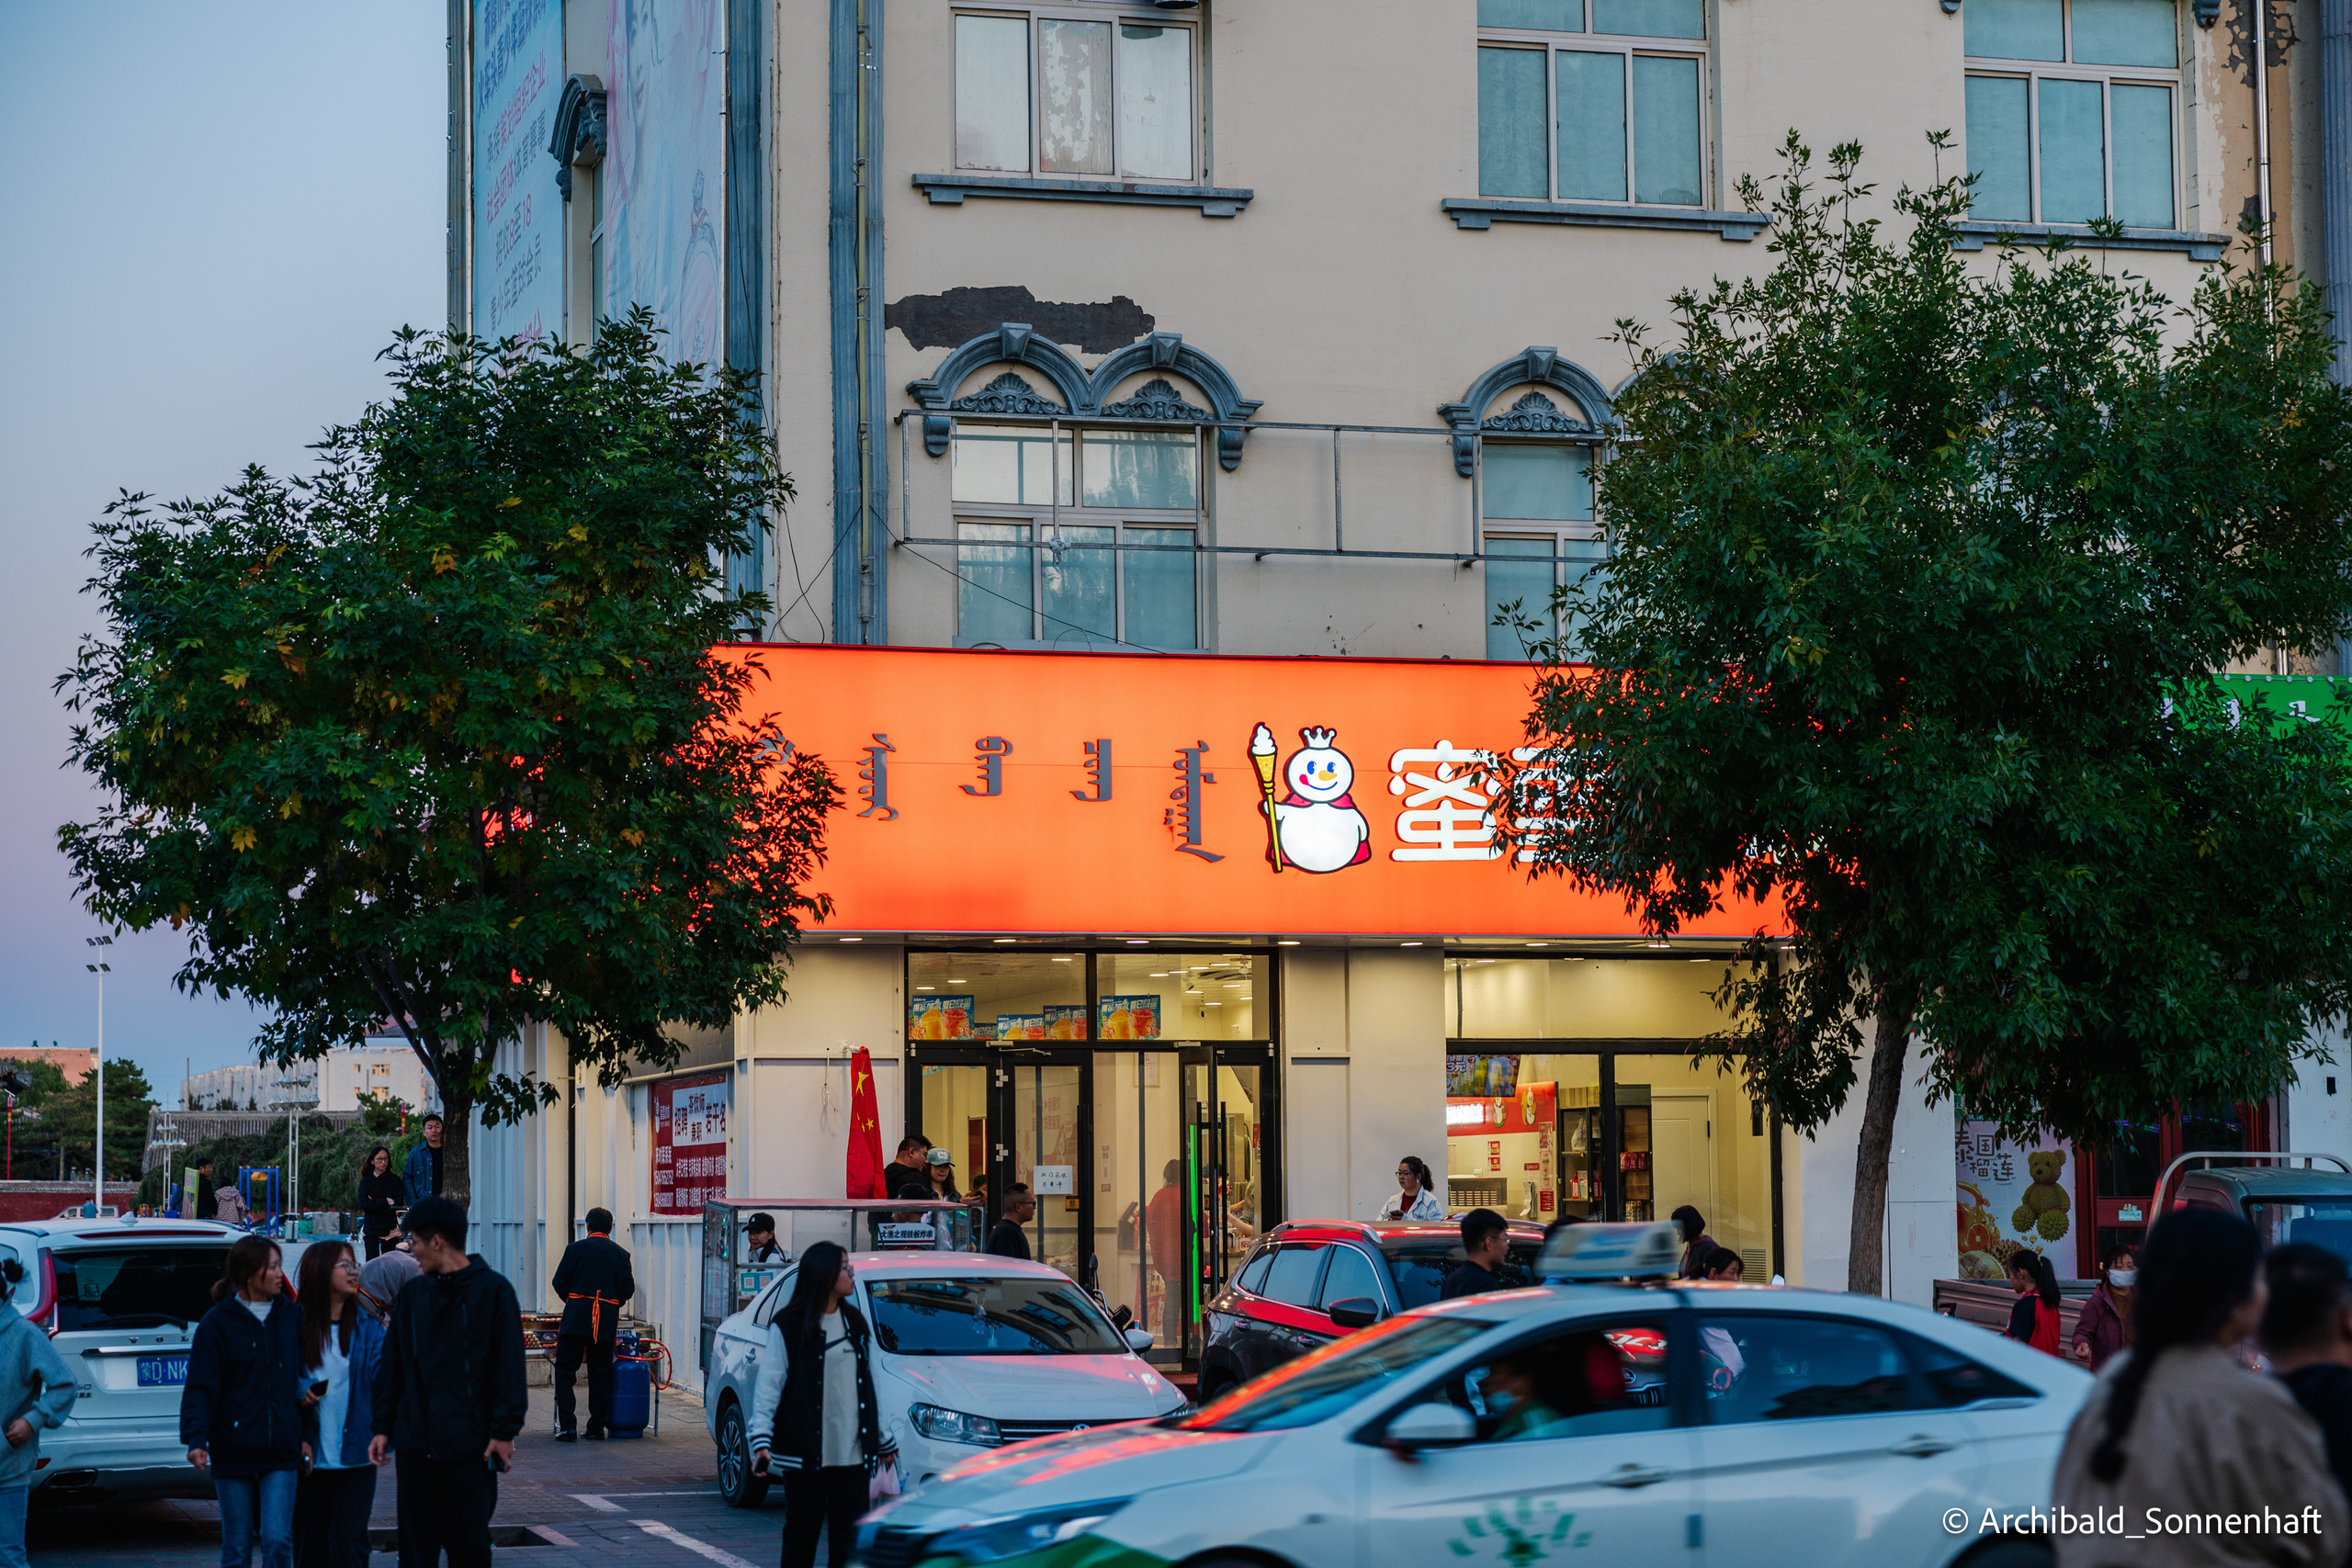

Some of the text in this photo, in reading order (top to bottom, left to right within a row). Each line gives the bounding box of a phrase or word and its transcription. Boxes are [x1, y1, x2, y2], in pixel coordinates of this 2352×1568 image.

[491, 232, 542, 336] 青少年篮球会员
[1969, 1152, 2015, 1181] 榴莲
[129, 1336, 189, 1345] VOL
[141, 1360, 189, 1382] 蒙D·NK
